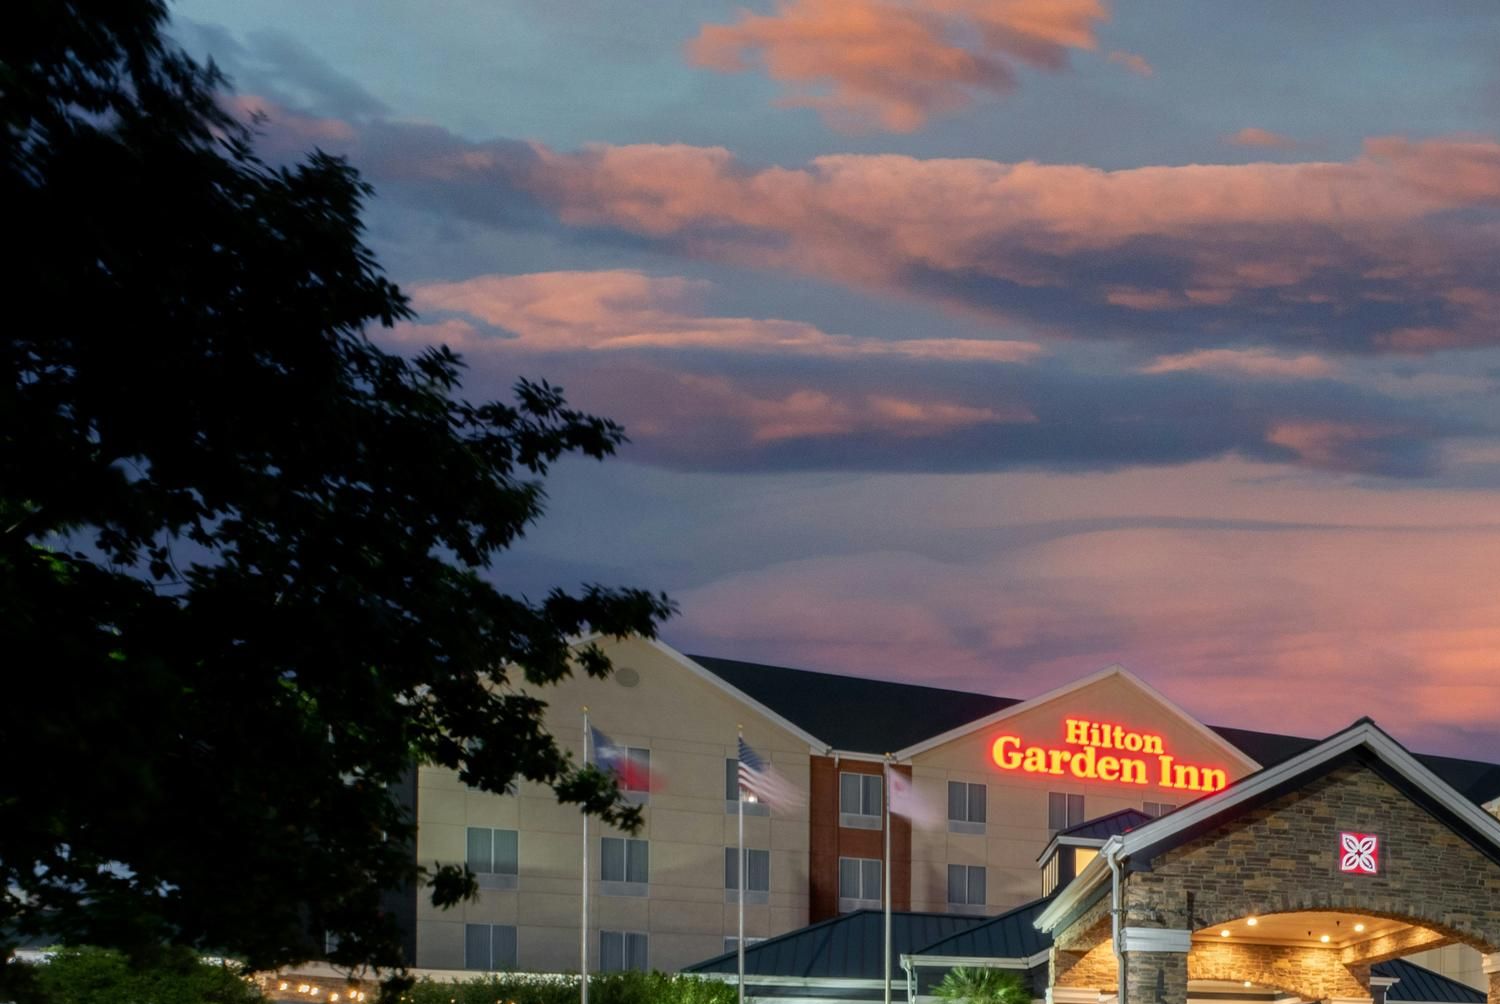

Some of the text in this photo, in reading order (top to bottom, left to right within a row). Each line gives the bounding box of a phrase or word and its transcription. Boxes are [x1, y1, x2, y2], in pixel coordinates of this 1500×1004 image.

[1065, 719, 1164, 754] Hilton
[992, 736, 1226, 791] Garden Inn
